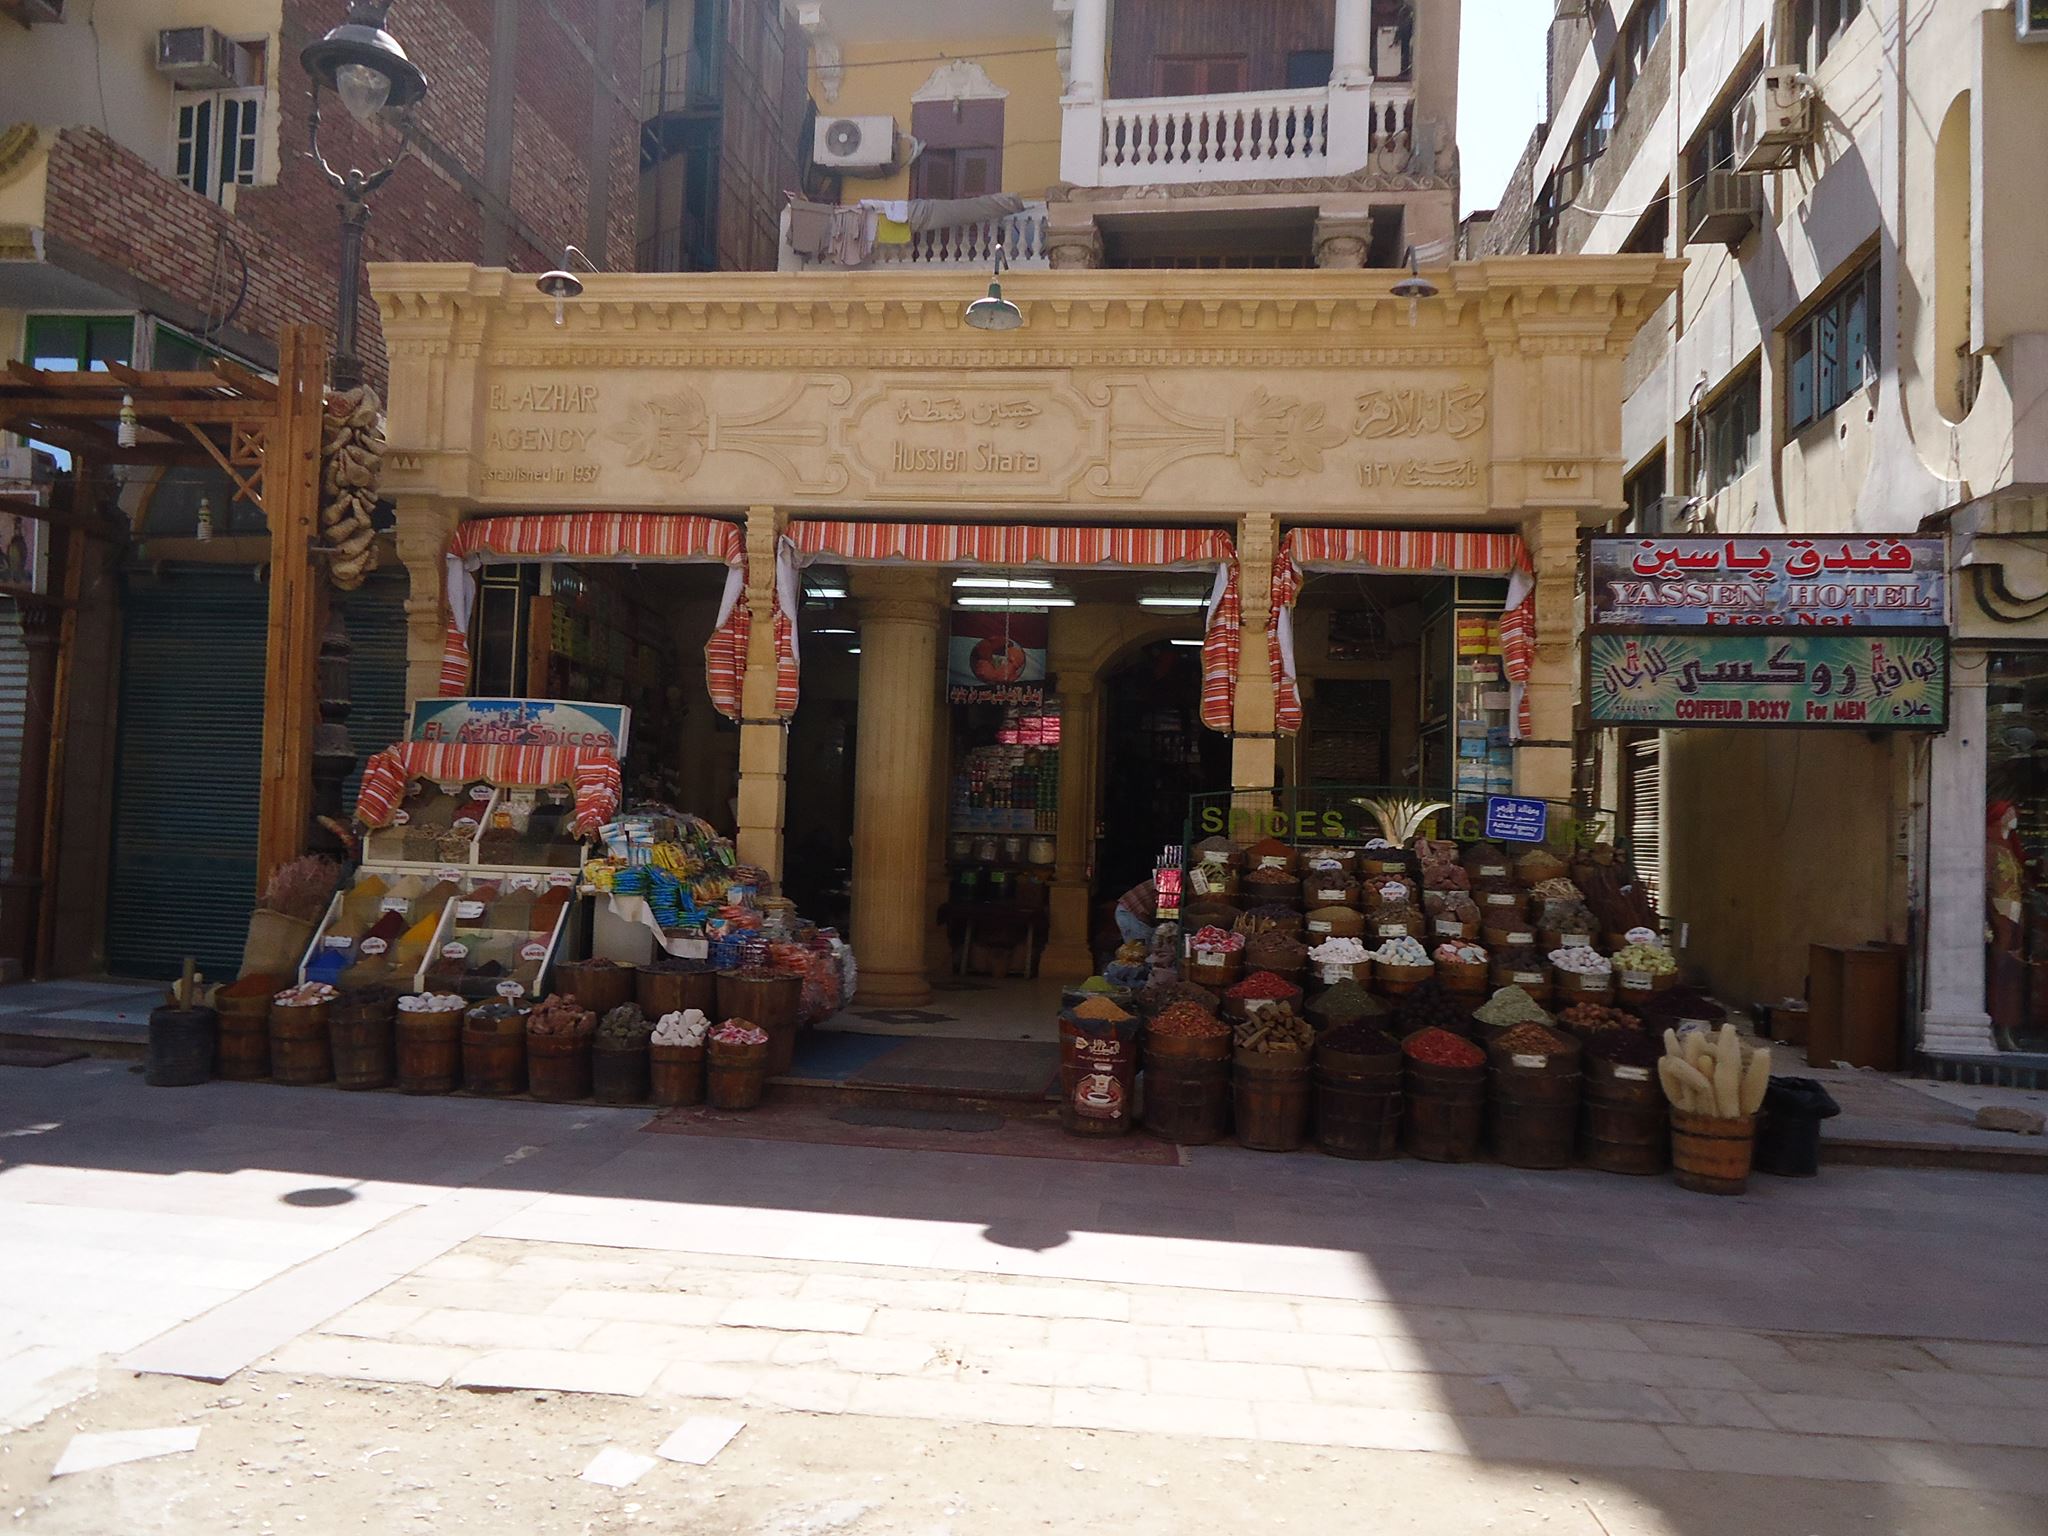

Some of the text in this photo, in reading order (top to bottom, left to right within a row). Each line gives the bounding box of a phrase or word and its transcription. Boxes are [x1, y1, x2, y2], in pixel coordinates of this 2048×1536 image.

[487, 426, 597, 452] AGENCY
[571, 463, 600, 483] 1937
[1632, 538, 1913, 580] فندق ياسين
[1608, 581, 1931, 611] YASSEN HOTEL
[1705, 611, 1854, 626] Free Net
[1675, 699, 1743, 720] COIFFEUR
[1748, 700, 1791, 721] ROXY
[1806, 700, 1828, 721] For
[1834, 701, 1866, 721] MEN
[1892, 699, 1931, 718] علاء
[457, 721, 524, 744] Azhar
[528, 724, 612, 748] Spices
[1200, 805, 1344, 837] SPICES
[1492, 821, 1539, 833] Azhar Agency
